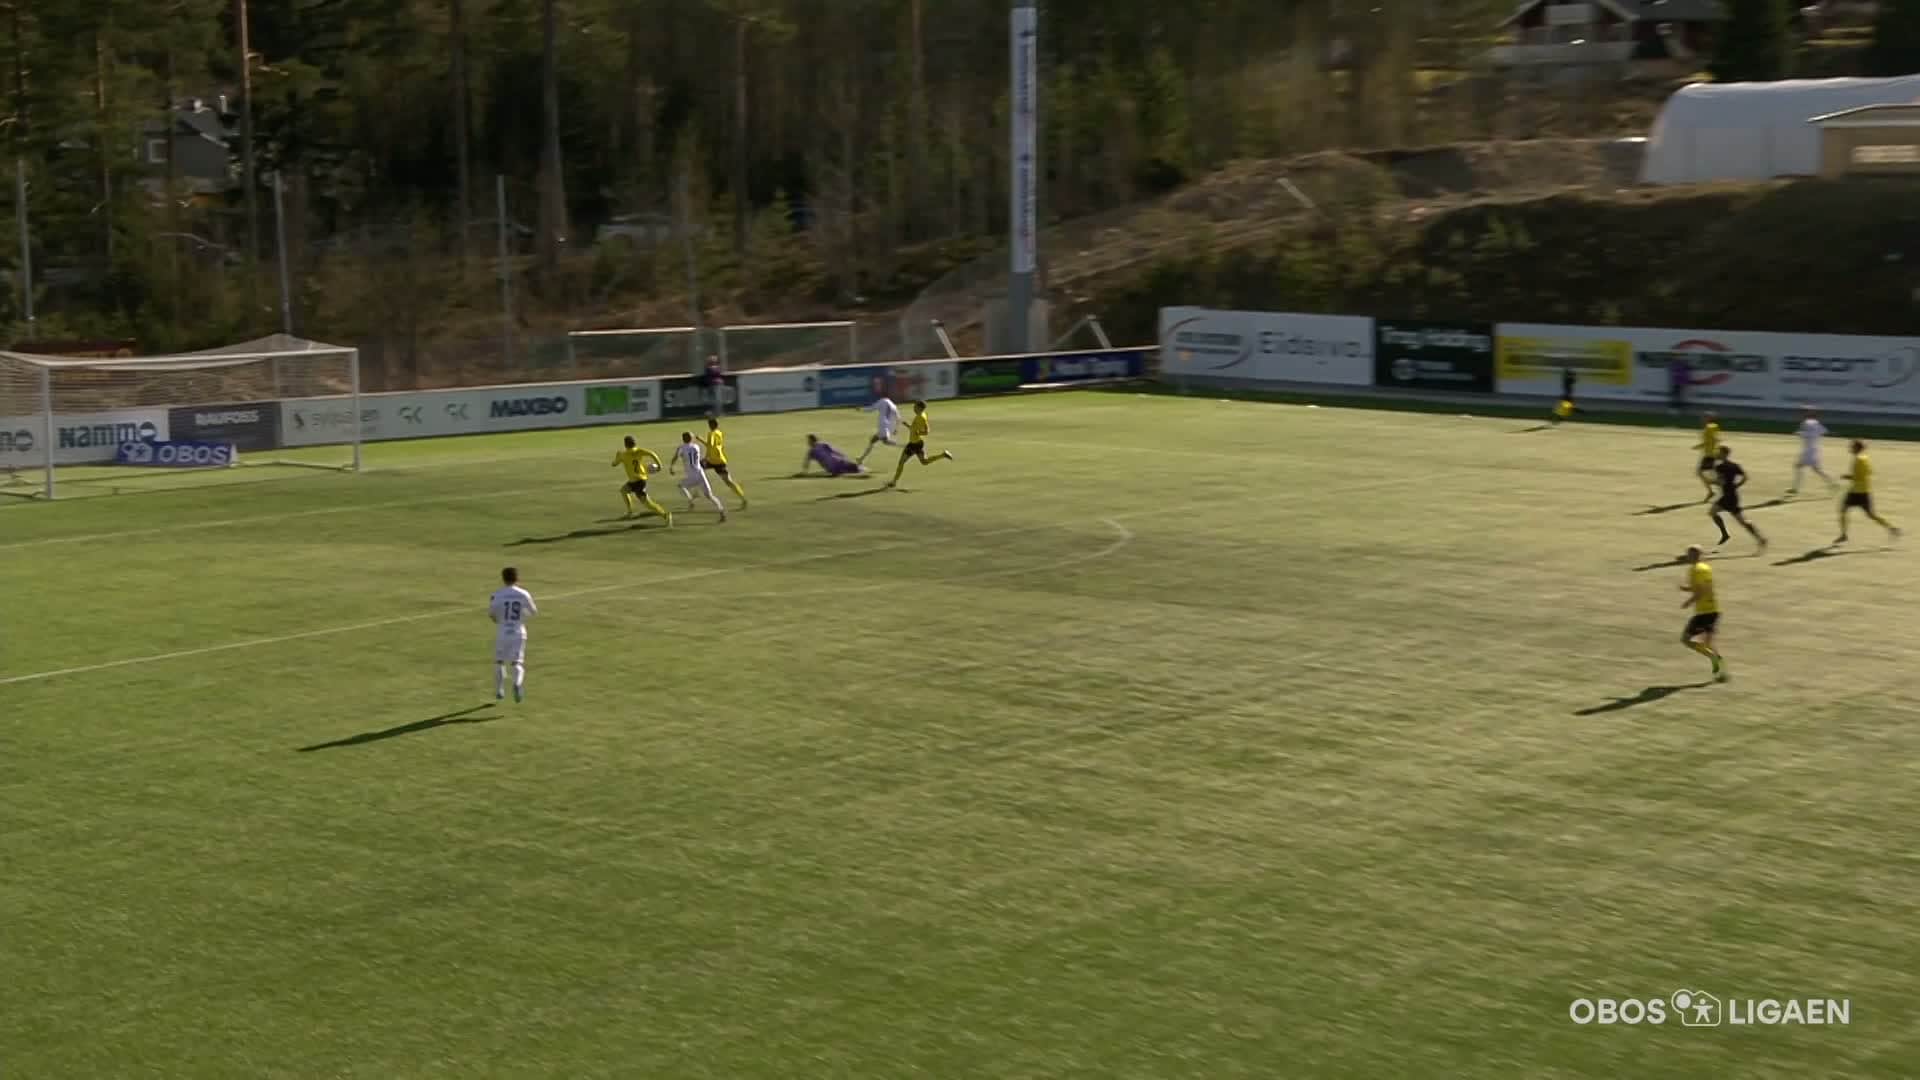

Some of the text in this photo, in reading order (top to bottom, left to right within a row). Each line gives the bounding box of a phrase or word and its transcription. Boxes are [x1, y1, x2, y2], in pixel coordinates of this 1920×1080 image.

[490, 397, 568, 417] MAXBO
[159, 445, 228, 463] OBOS
[504, 601, 521, 620] 19
